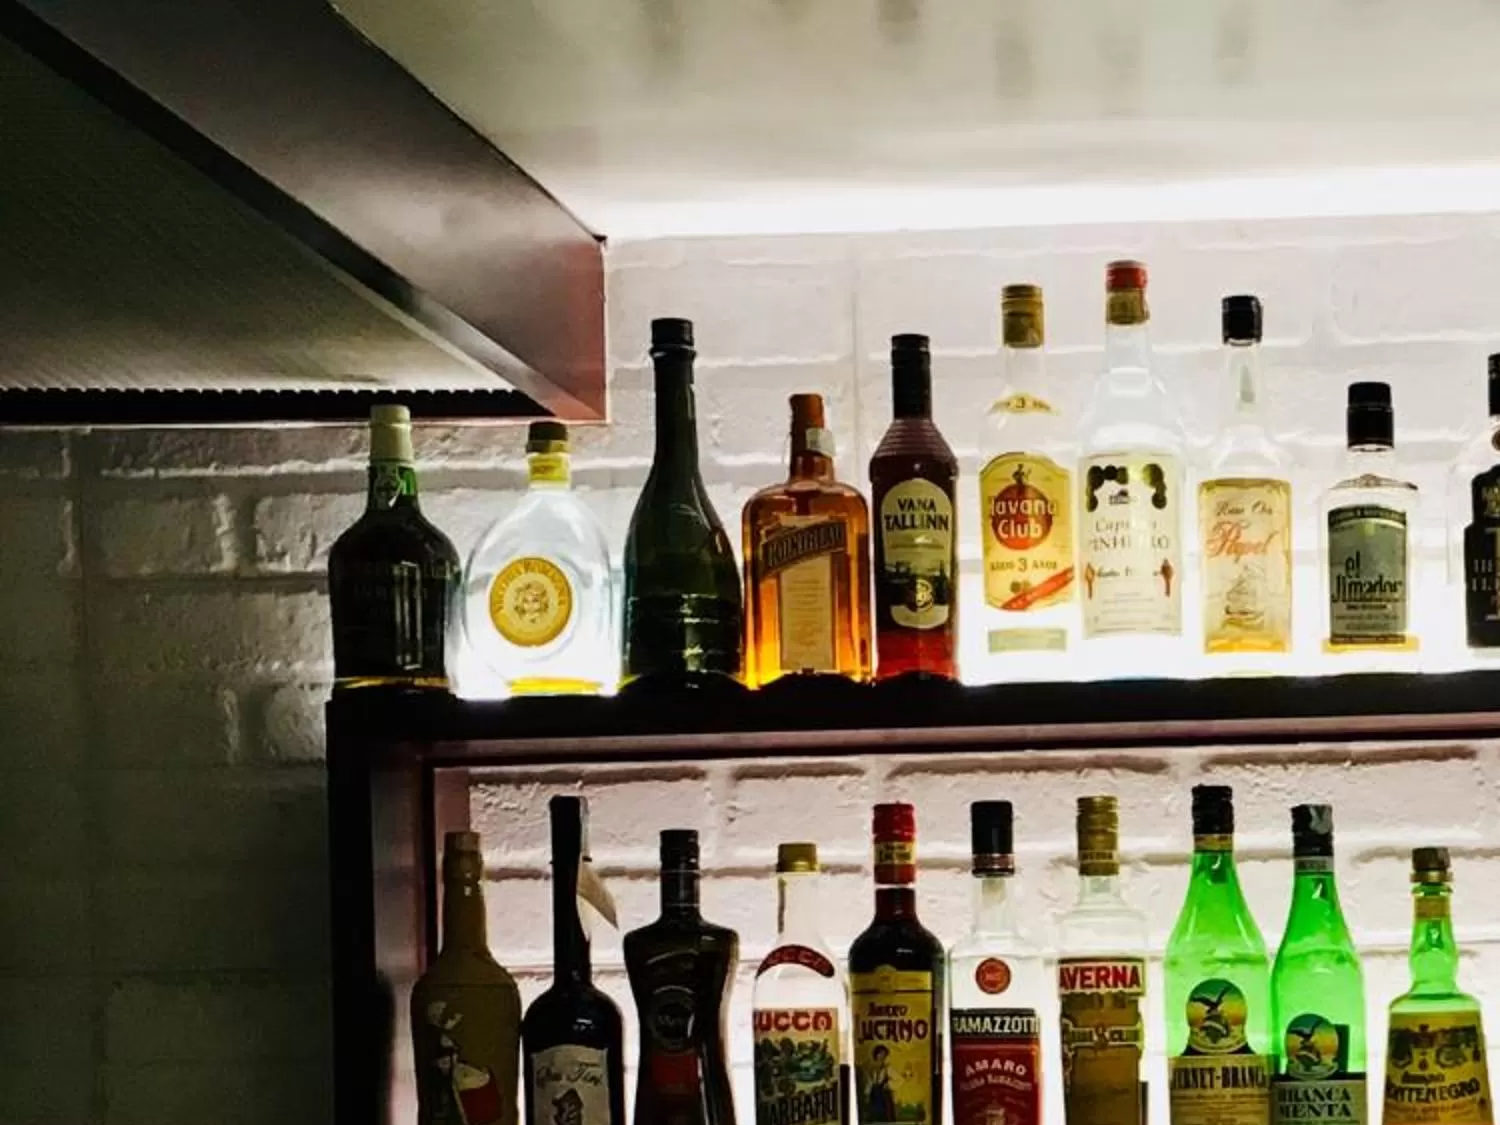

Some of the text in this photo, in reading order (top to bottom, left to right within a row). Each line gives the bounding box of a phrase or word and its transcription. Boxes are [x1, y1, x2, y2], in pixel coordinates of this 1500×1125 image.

[896, 498, 936, 513] VANA
[885, 514, 949, 531] TALLINN
[997, 518, 1044, 539] Club
[1345, 550, 1361, 578] el
[1058, 964, 1141, 990] AVERNA
[964, 1058, 1028, 1077] AMARO
[1170, 1064, 1271, 1090] ERNET-BRANC
